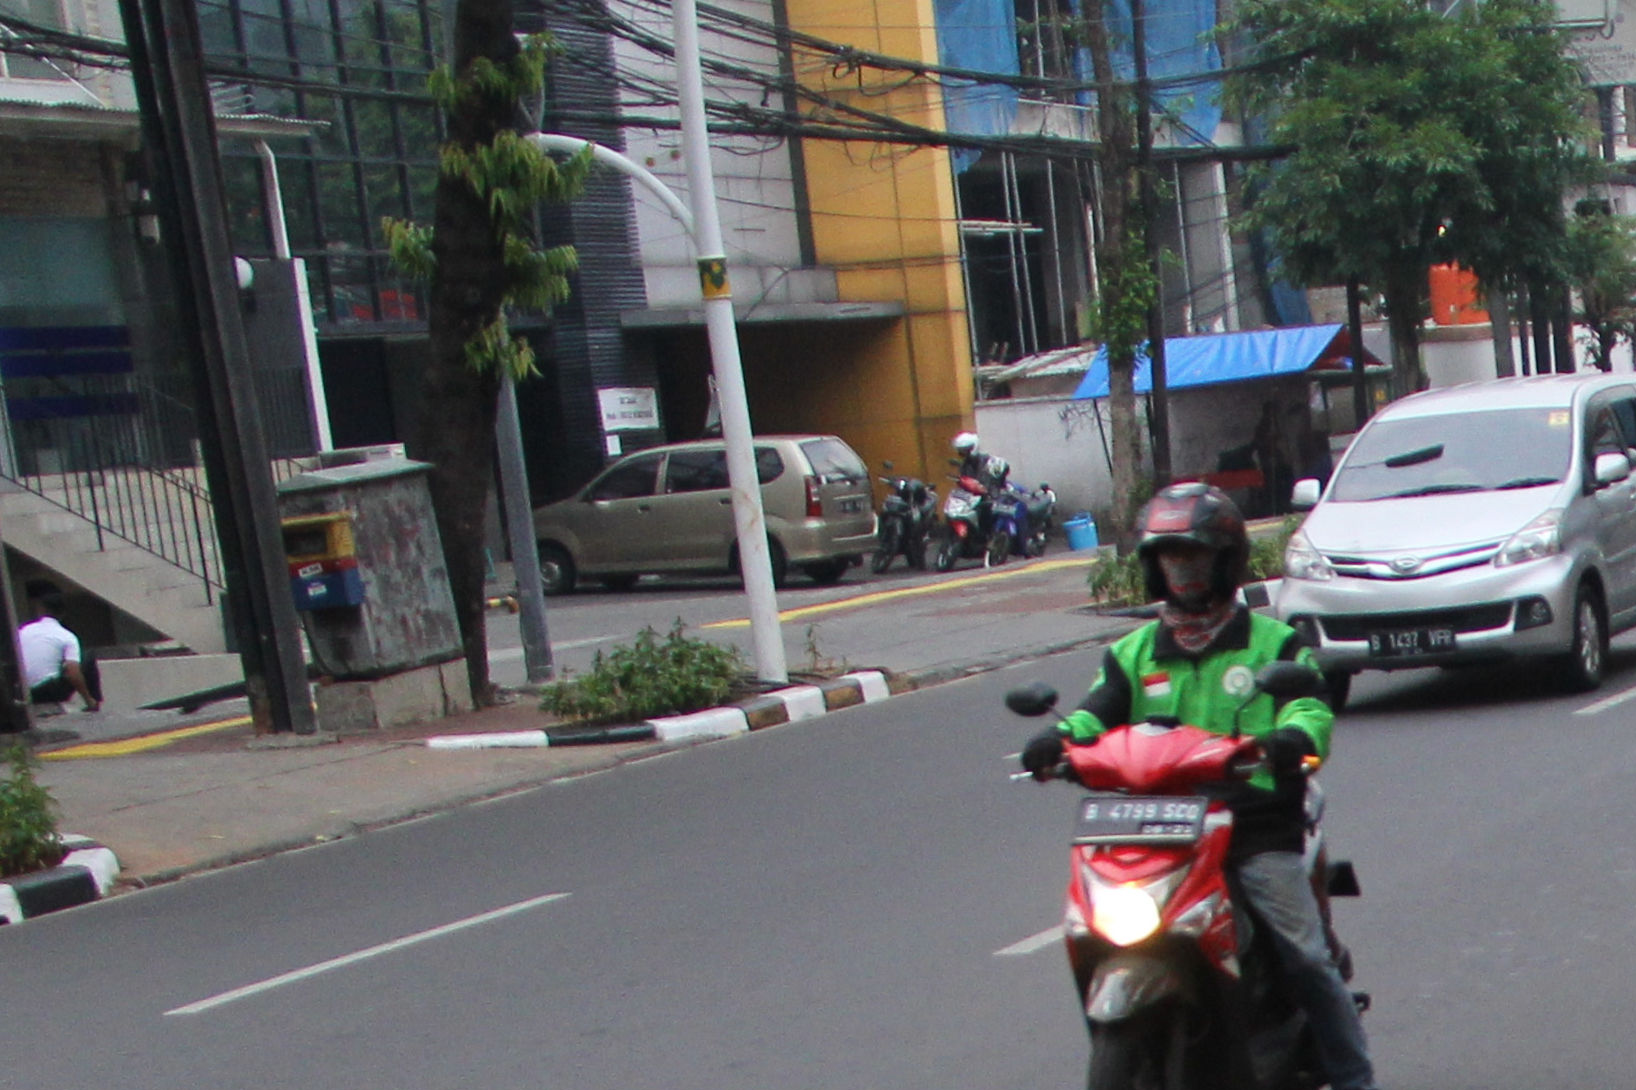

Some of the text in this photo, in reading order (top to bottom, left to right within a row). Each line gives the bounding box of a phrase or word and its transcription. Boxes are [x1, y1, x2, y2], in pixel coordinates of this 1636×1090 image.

[1371, 634, 1381, 651] B
[1085, 803, 1099, 820] B
[1109, 803, 1158, 819] 4799
